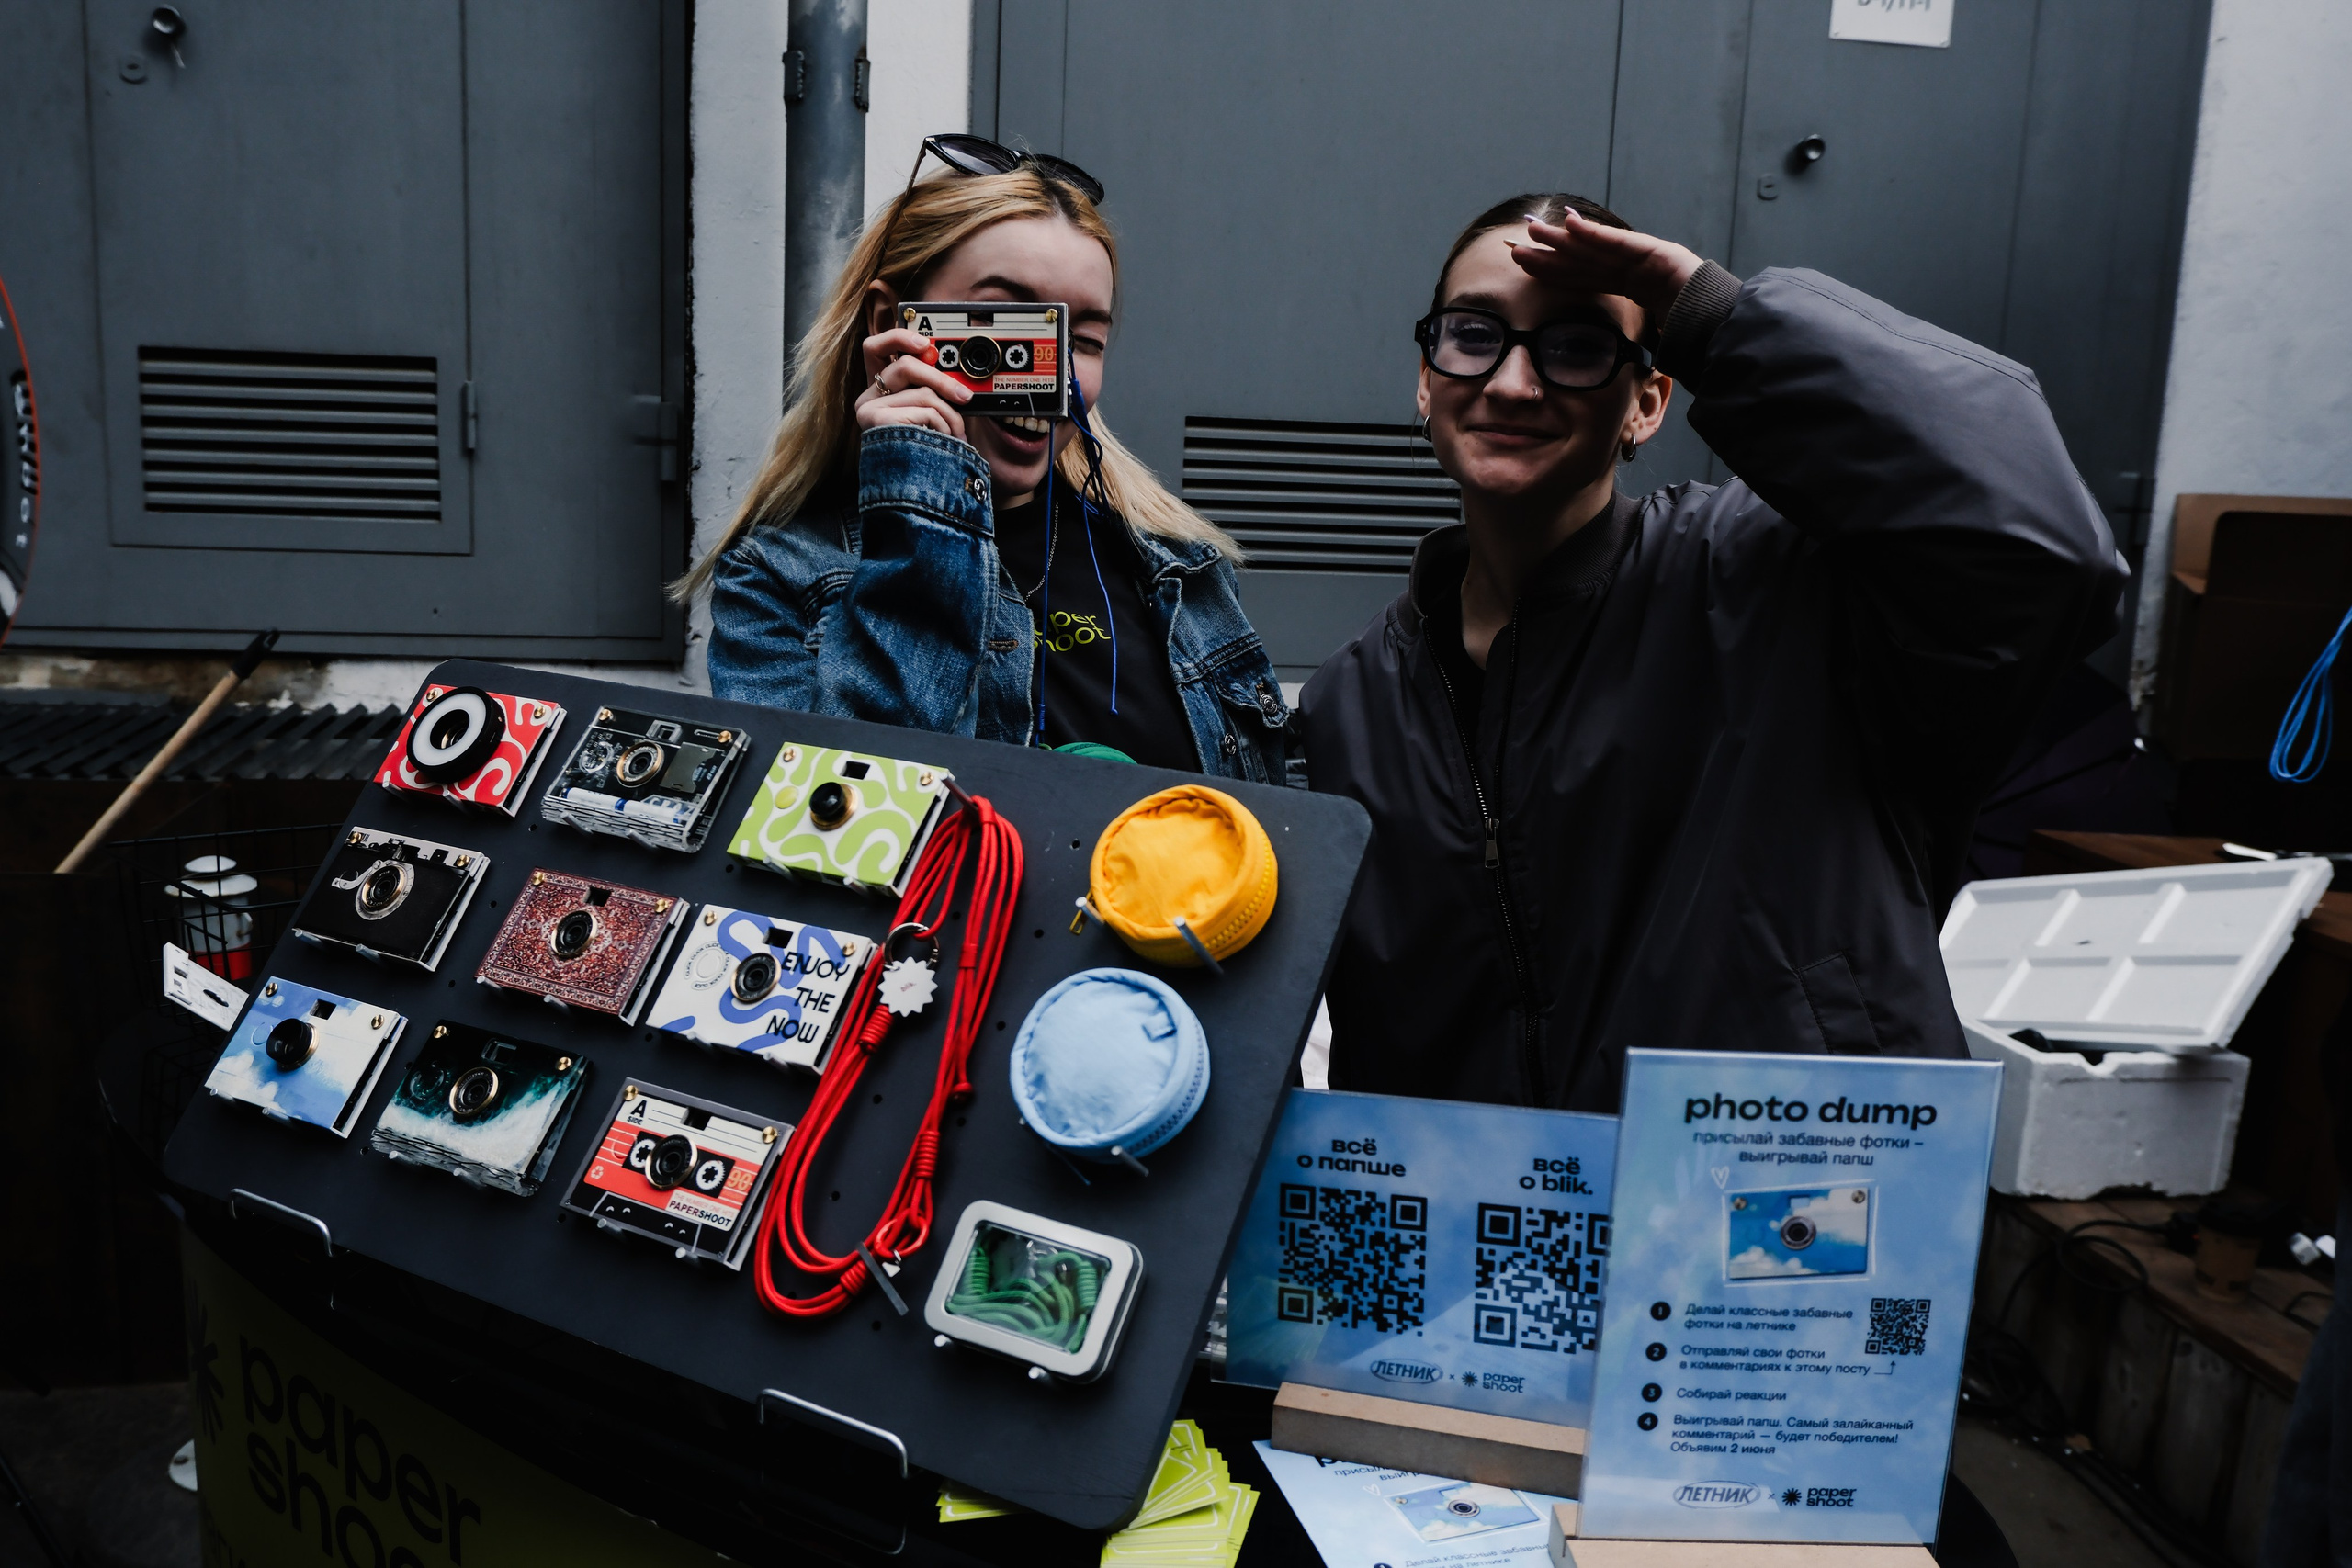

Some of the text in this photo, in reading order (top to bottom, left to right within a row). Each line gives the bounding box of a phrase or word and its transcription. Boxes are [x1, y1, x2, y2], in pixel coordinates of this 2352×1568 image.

[918, 316, 933, 331] A
[1035, 346, 1054, 362] 90
[1034, 611, 1096, 637] per
[1034, 626, 1112, 652] hoot
[782, 952, 850, 982] ENJOY
[796, 987, 837, 1013] THE
[766, 1015, 820, 1043] NOW
[630, 1100, 647, 1118] A
[1684, 1092, 1937, 1131] photo dump
[627, 1115, 643, 1125] SIDE
[1331, 1137, 1377, 1156] всё
[1693, 1132, 1773, 1145] присылай
[1778, 1132, 1855, 1147] забавные
[1860, 1134, 1910, 1150] фотки
[1296, 1155, 1406, 1177] о папше
[1532, 1156, 1581, 1175] всё
[1738, 1151, 1874, 1166] выигрывай папш
[729, 1170, 752, 1191] 90
[1519, 1174, 1593, 1196] о blik.
[669, 1200, 732, 1227] PAPERSHOOT
[1685, 1303, 1853, 1319] Делай классные забавные
[1684, 1319, 1796, 1332] фотки на летнике
[1681, 1344, 1826, 1359] Отправляй свои фотки
[1376, 1360, 1437, 1381] ЛЕТНИК
[1679, 1361, 1871, 1376] в комментариях к этому посту
[1482, 1371, 1525, 1384] paper
[1482, 1381, 1524, 1393] shoot
[1677, 1387, 1787, 1402] Собирай реакции
[1673, 1414, 1914, 1430] Выигрывай папш. Самый залайканный
[1672, 1430, 1755, 1441] комментарий
[1775, 1430, 1811, 1444] будет
[1814, 1431, 1898, 1444] победителем!
[239, 1334, 481, 1566] paper
[1670, 1441, 1775, 1454] Объявим 2 июня
[1334, 1466, 1389, 1476] присы
[245, 1431, 427, 1568] sho
[1678, 1484, 1755, 1504] ЛЕТНИК
[1807, 1487, 1857, 1498] paper
[1806, 1497, 1854, 1507] shoot
[1405, 1556, 1442, 1567] Делай
[1444, 1551, 1498, 1562] классные
